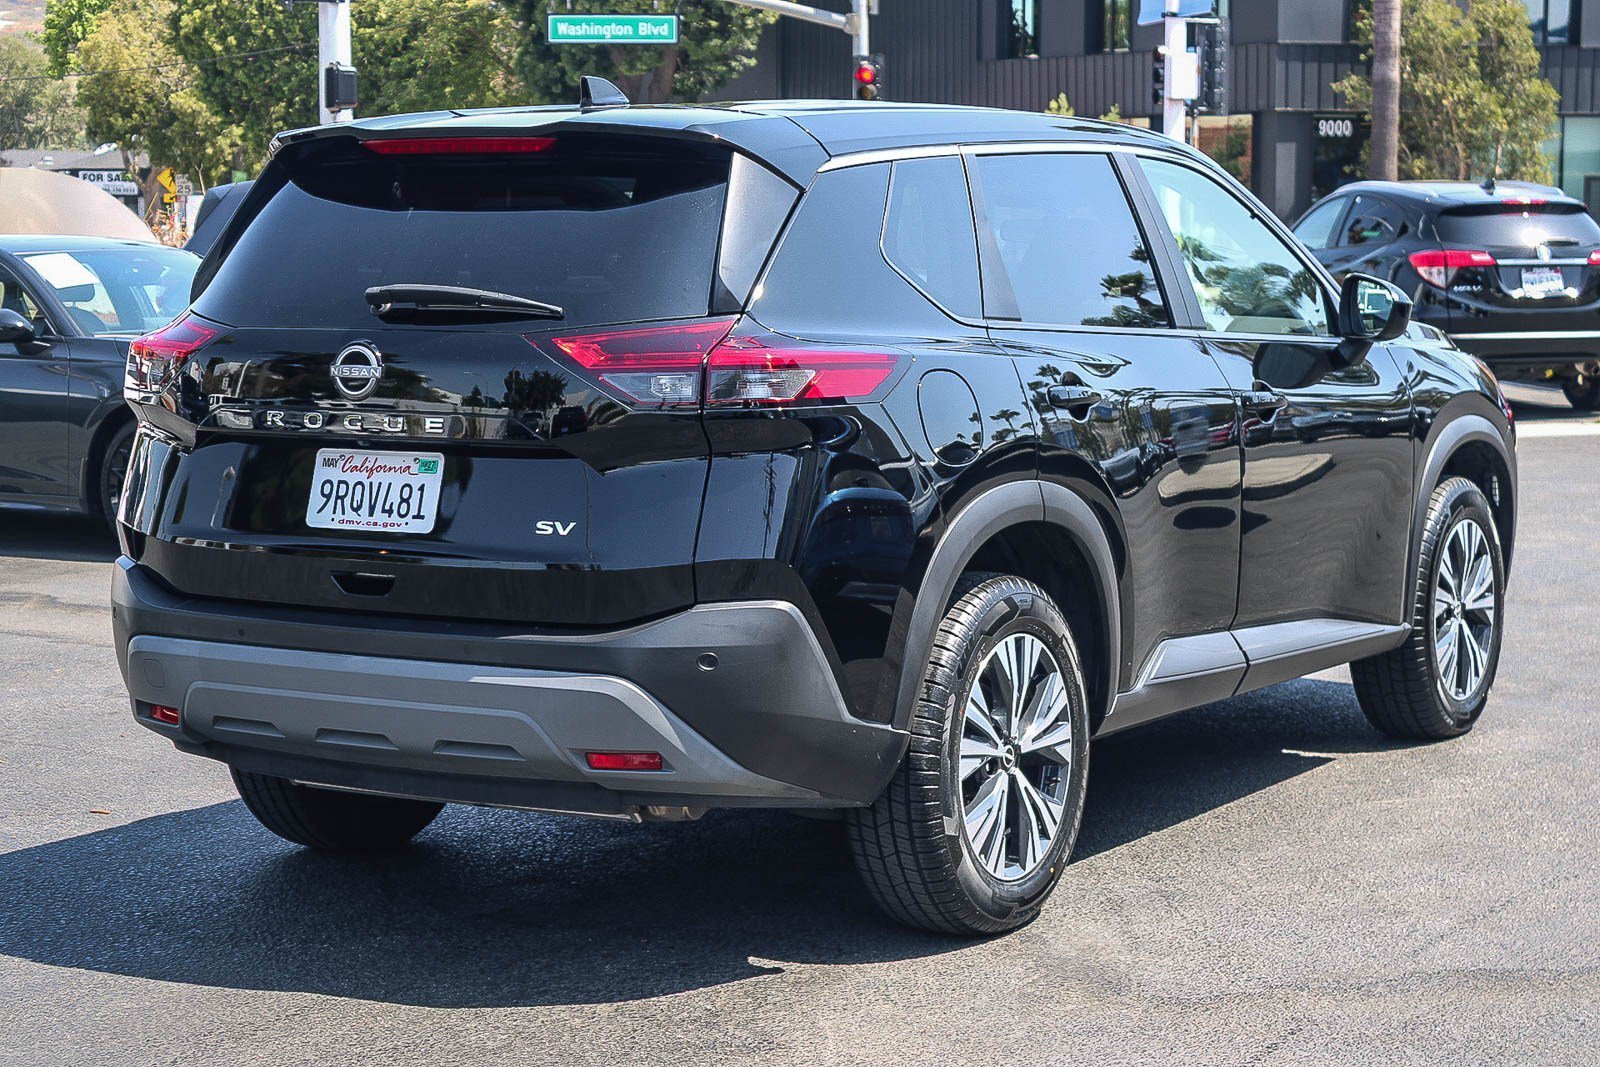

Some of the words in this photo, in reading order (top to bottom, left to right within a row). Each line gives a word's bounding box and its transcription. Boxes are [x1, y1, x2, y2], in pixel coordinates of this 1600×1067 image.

[556, 22, 633, 39] Washington
[638, 22, 669, 36] Blvd
[1318, 119, 1353, 137] 9000
[82, 173, 104, 182] FOR
[107, 173, 131, 182] SAL
[331, 366, 381, 377] NISSAN
[267, 411, 444, 433] ROGUE
[322, 457, 340, 468] MAY
[341, 455, 419, 479] California
[316, 479, 426, 520] 9RQV481
[338, 518, 403, 528] dmv.ca.gov
[535, 520, 577, 536] SV
